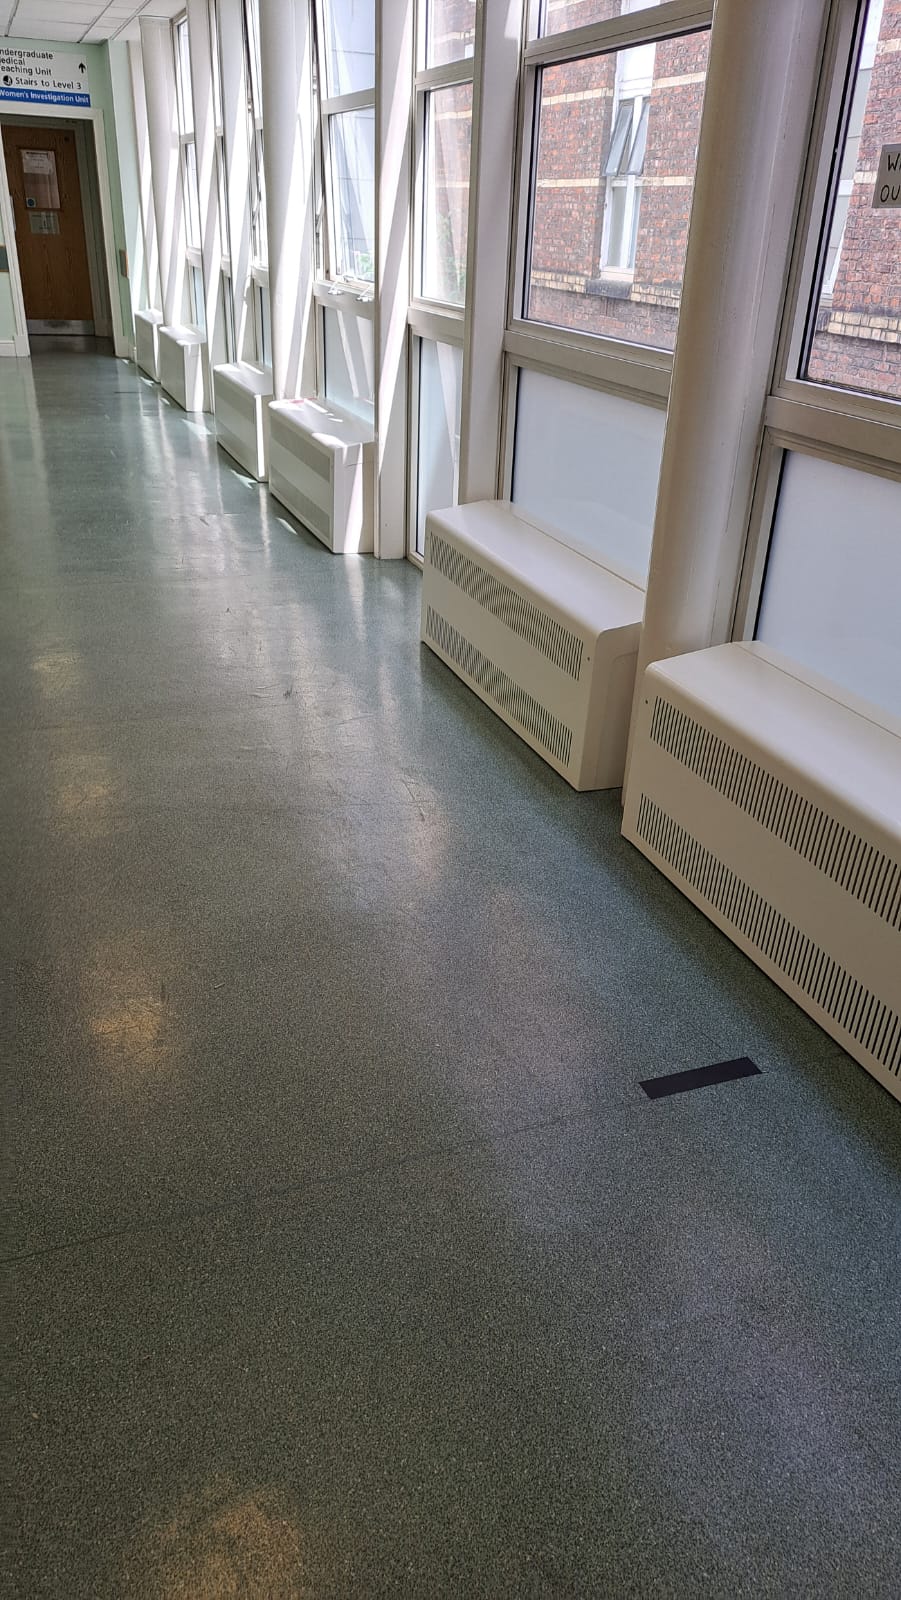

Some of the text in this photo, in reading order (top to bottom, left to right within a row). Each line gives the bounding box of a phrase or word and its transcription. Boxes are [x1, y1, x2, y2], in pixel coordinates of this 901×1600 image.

[0, 48, 53, 60] ndergraduate
[0, 57, 25, 66] edical
[1, 65, 52, 76] eaching Unit
[15, 77, 82, 90] Stairs to Level 3
[0, 89, 89, 103] Women's Investigation Unit
[888, 153, 901, 171] W
